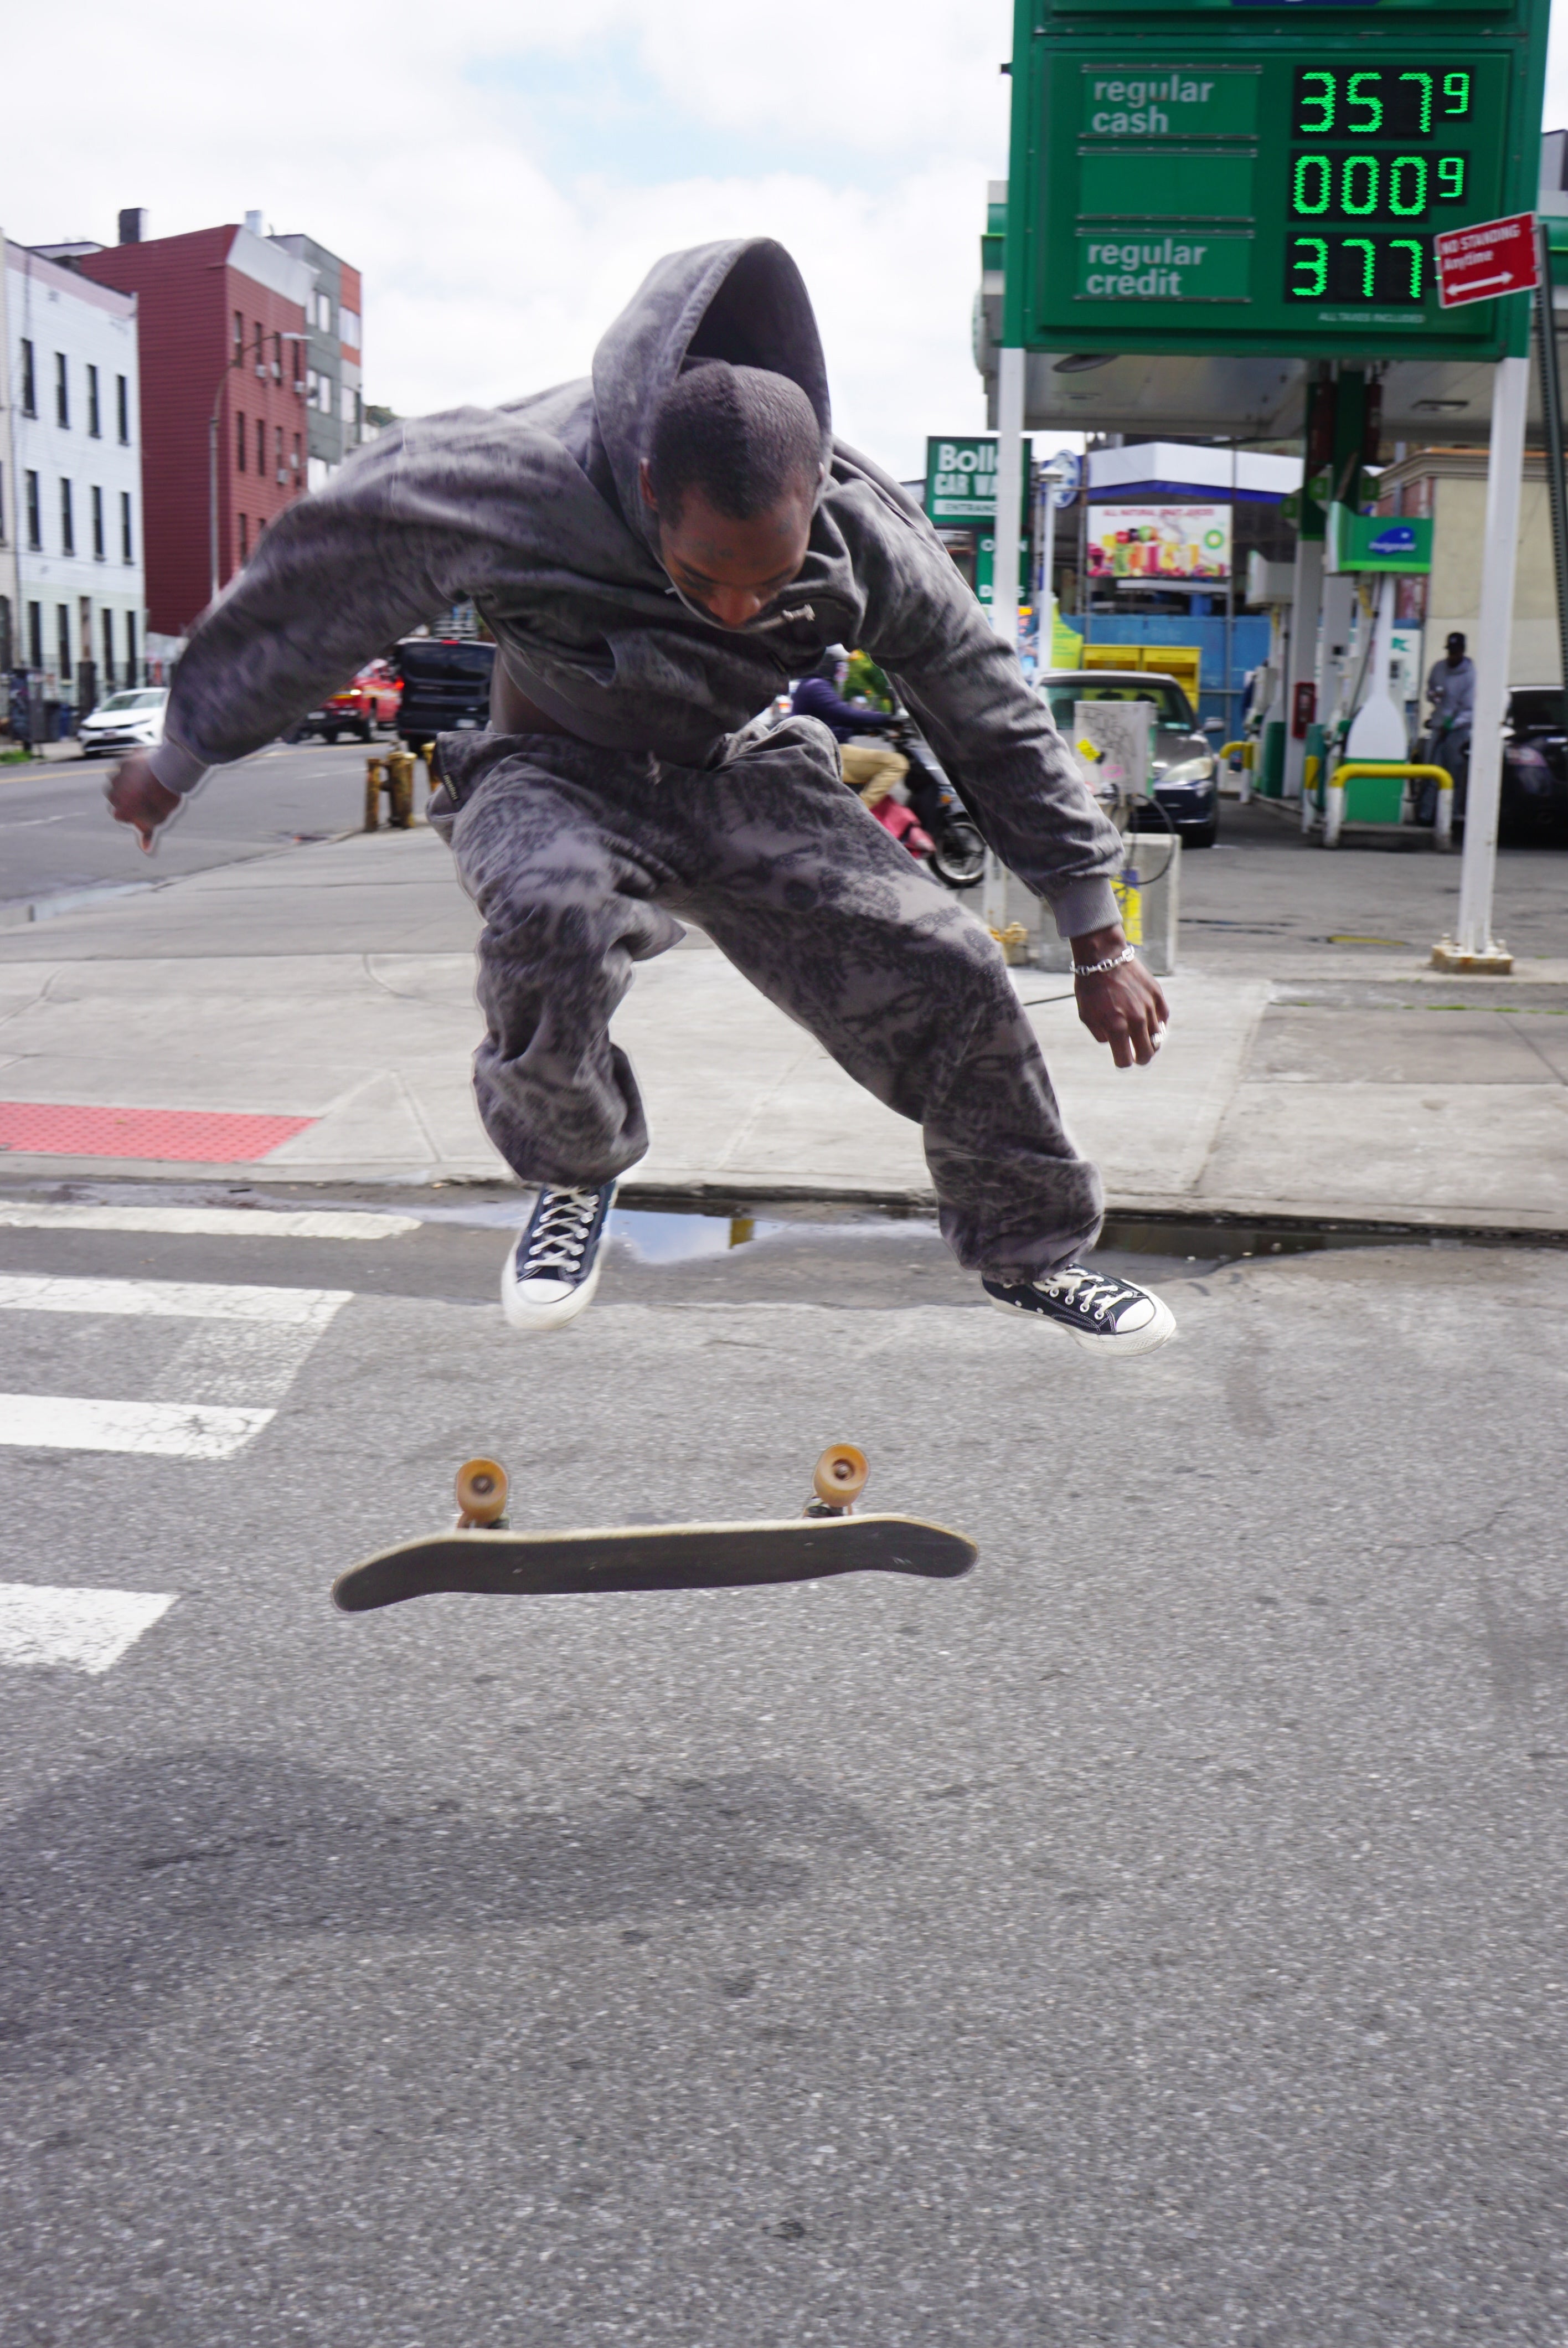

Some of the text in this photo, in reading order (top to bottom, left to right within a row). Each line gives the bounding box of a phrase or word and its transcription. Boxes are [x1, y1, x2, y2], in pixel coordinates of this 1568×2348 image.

[1094, 74, 1215, 108] regular
[1092, 105, 1169, 133] cash
[1441, 224, 1520, 255] NO STANDING
[1088, 238, 1208, 271] regular
[1443, 250, 1493, 271] Anytime
[1086, 269, 1182, 296] credit
[934, 473, 968, 495] CAR
